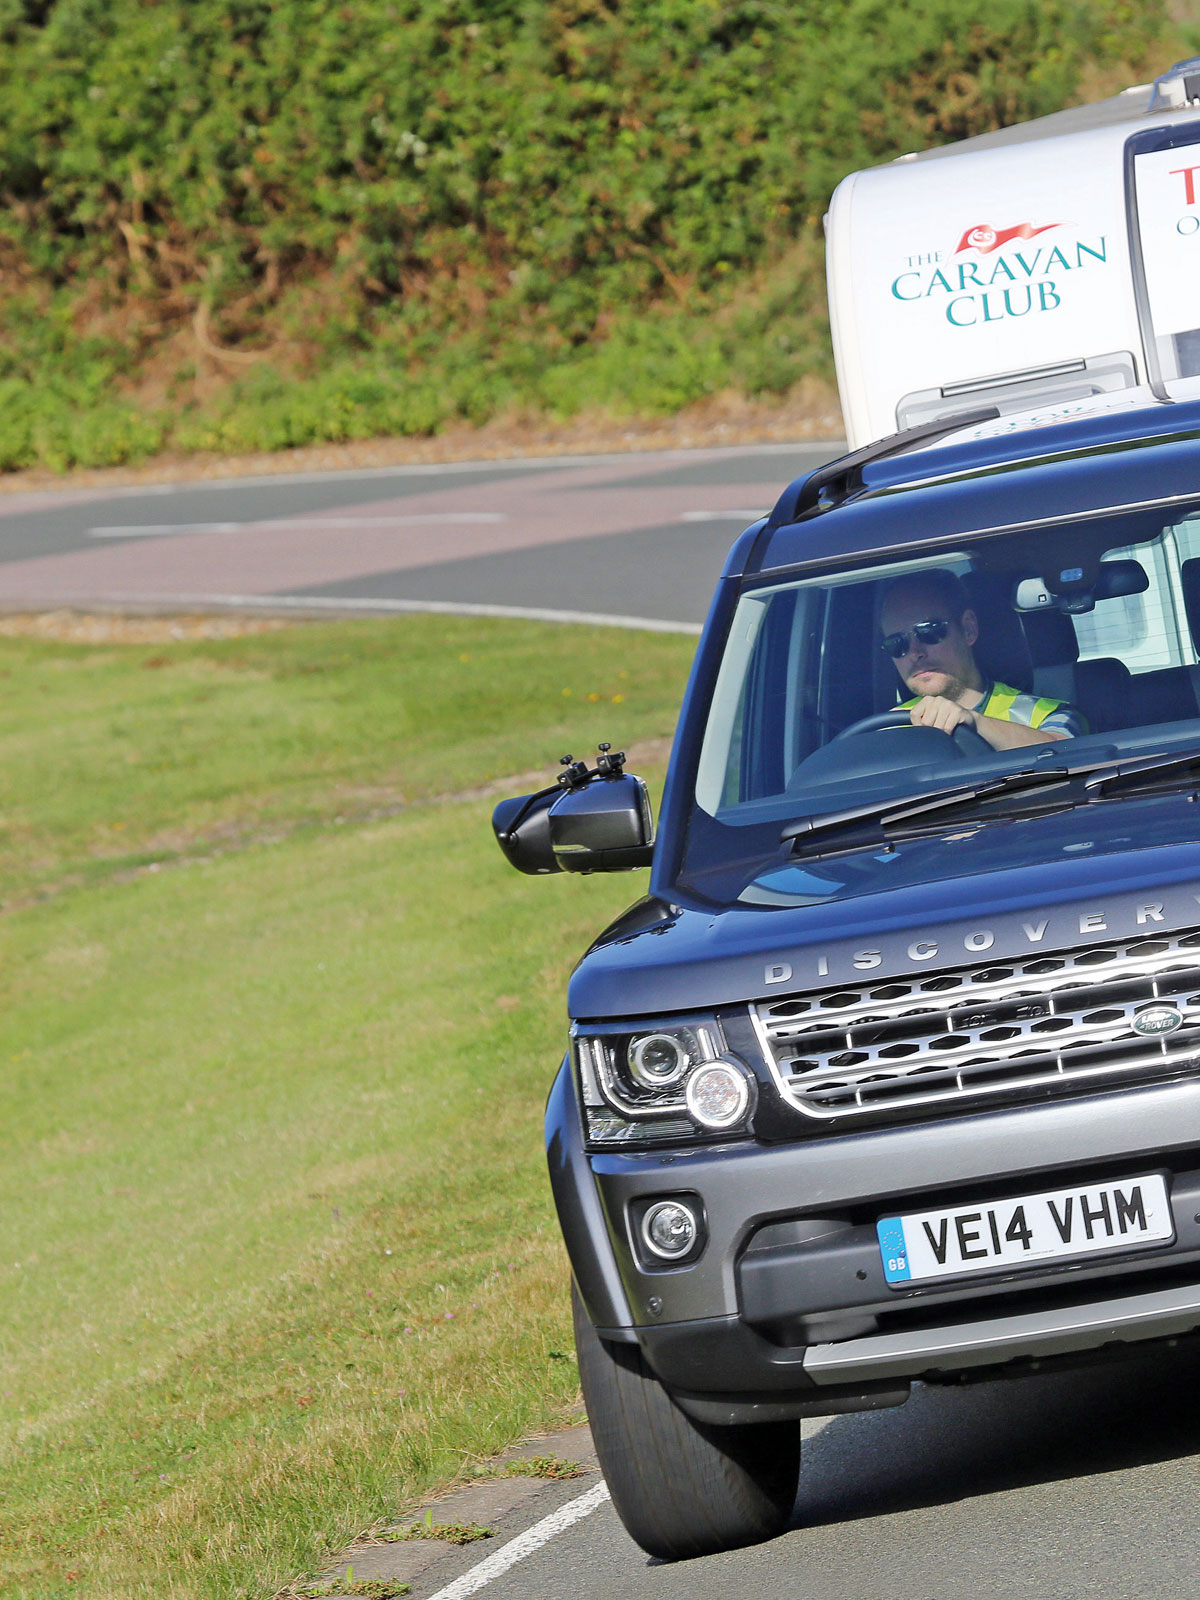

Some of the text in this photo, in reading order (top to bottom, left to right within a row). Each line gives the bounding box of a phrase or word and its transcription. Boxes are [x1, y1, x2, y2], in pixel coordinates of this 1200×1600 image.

[891, 236, 1108, 301] CARAVAN
[905, 251, 944, 268] THE
[945, 280, 1062, 327] CLUB
[1145, 1018, 1174, 1030] ROVER
[922, 1186, 1148, 1265] VE14 VHM
[888, 1257, 906, 1271] GB
